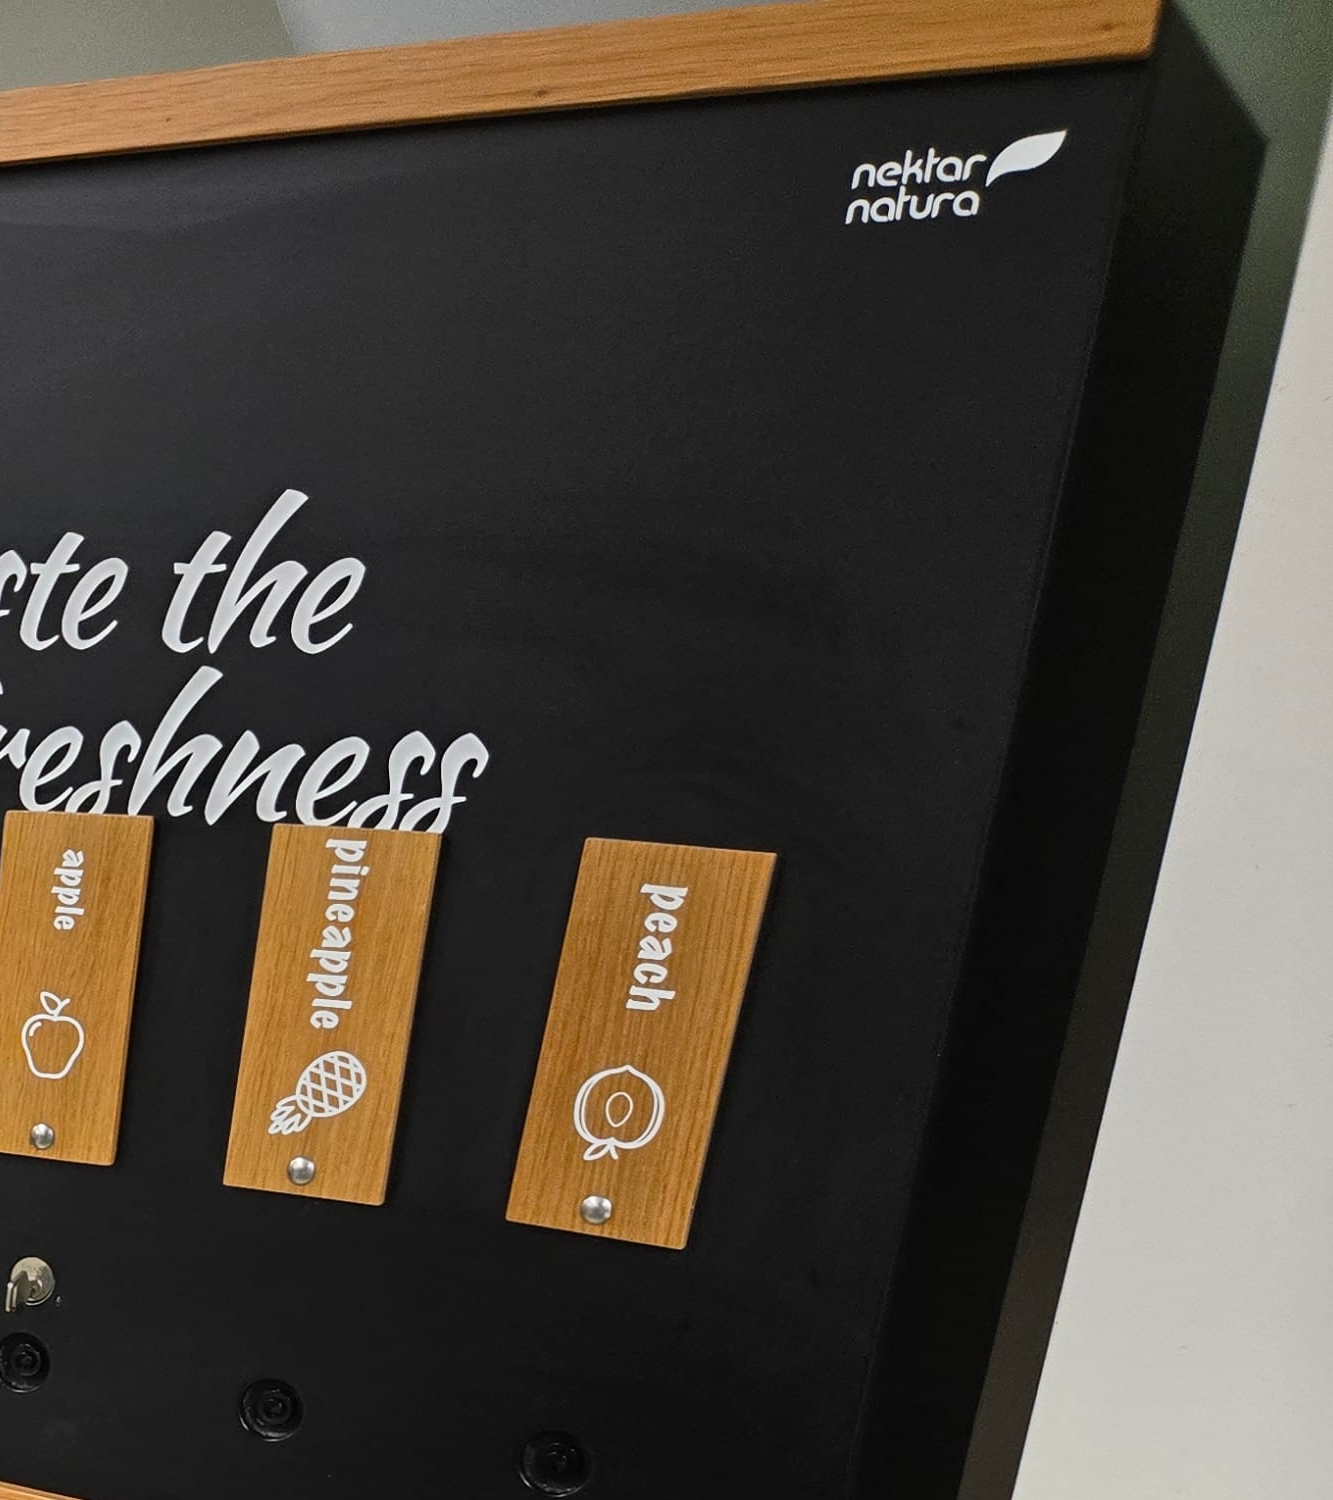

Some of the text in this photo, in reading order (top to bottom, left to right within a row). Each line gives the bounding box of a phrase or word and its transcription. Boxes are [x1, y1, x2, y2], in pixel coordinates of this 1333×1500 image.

[844, 185, 981, 226] natura
[851, 147, 988, 190] nektar
[161, 488, 367, 656] the
[50, 848, 86, 932] apple
[305, 837, 371, 1031] pineapple
[624, 882, 690, 1012] peach
